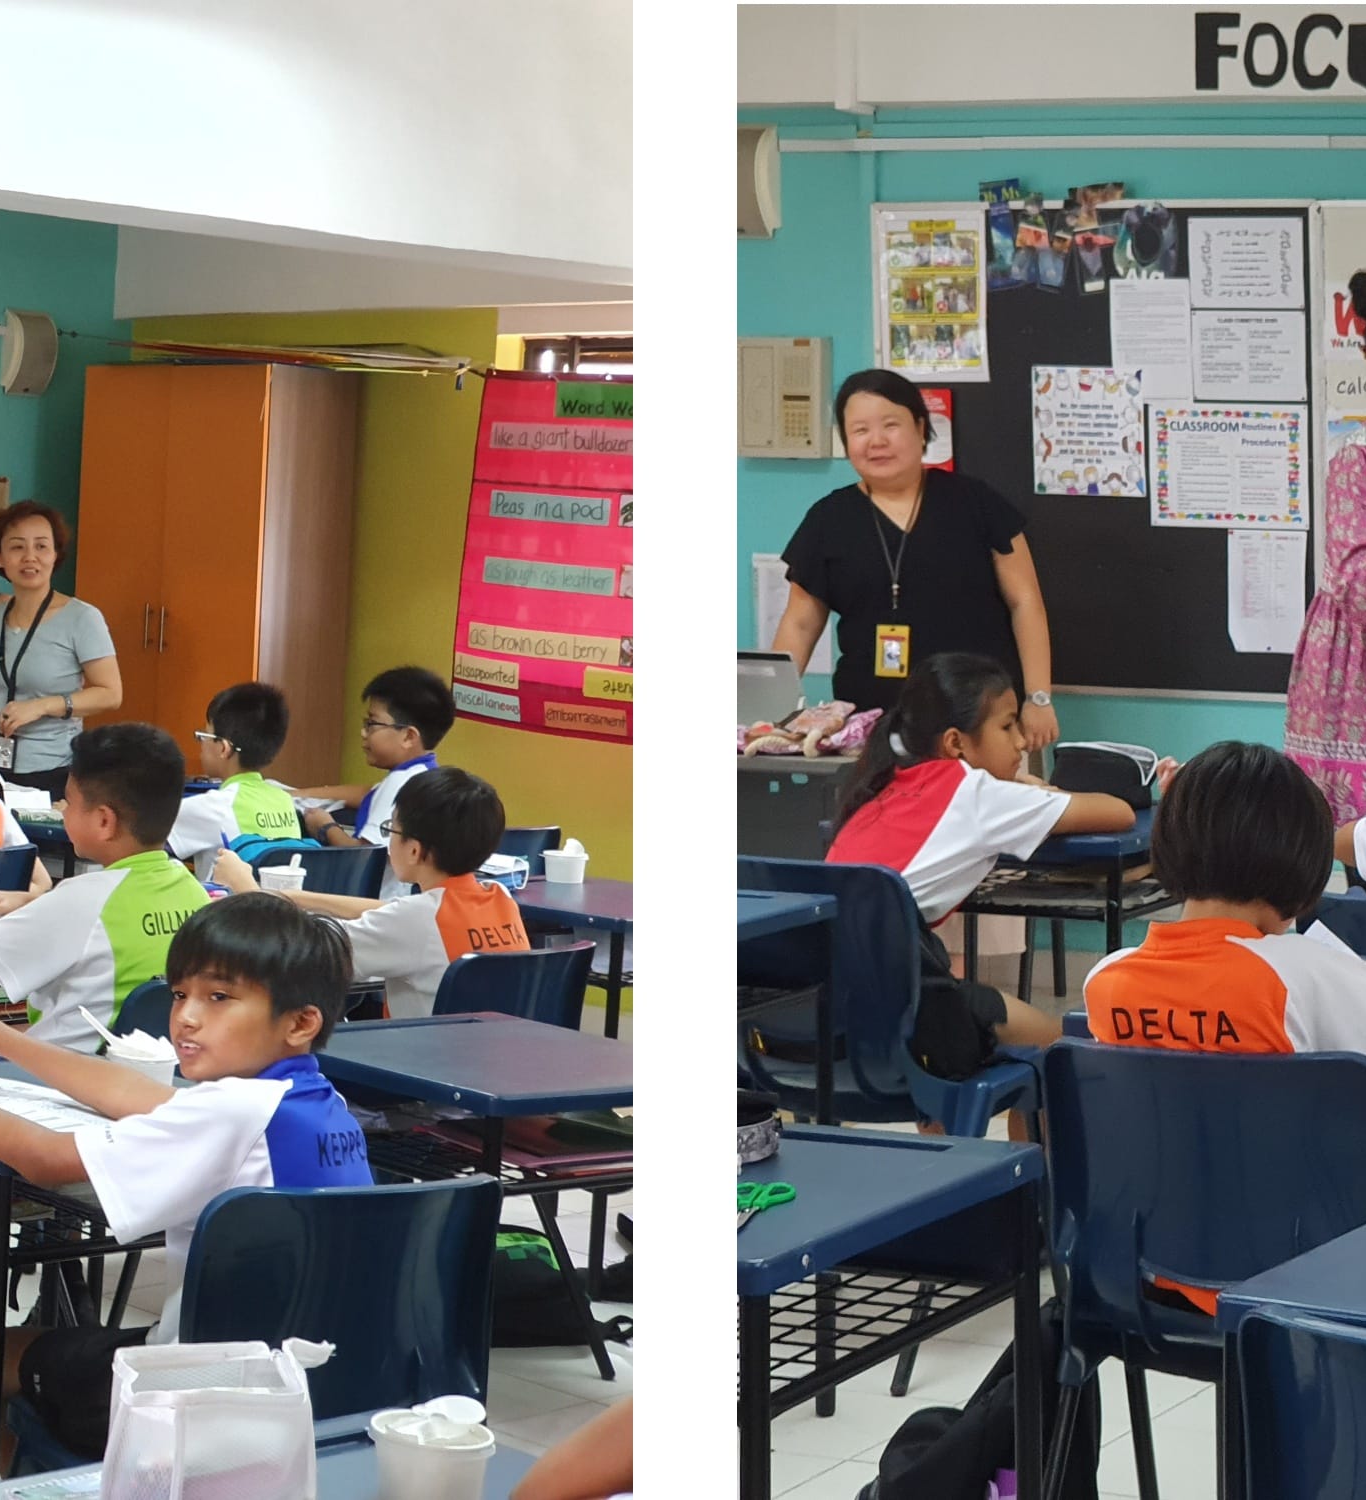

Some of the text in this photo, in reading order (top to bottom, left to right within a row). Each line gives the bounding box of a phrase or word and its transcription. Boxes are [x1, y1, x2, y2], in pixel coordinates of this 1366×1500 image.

[561, 399, 605, 415] Word
[494, 427, 633, 451] like a giant bulldozer
[1170, 421, 1286, 432] CLASSROOM Routines &
[1241, 438, 1287, 447] Procedures
[495, 492, 603, 520] Peas in a pod
[540, 570, 556, 585] as
[562, 568, 612, 590] leather
[470, 626, 608, 662] as brown as a berry
[455, 655, 515, 685] disappointed
[467, 923, 525, 951] DELTA
[1111, 1007, 1240, 1044] DELTA
